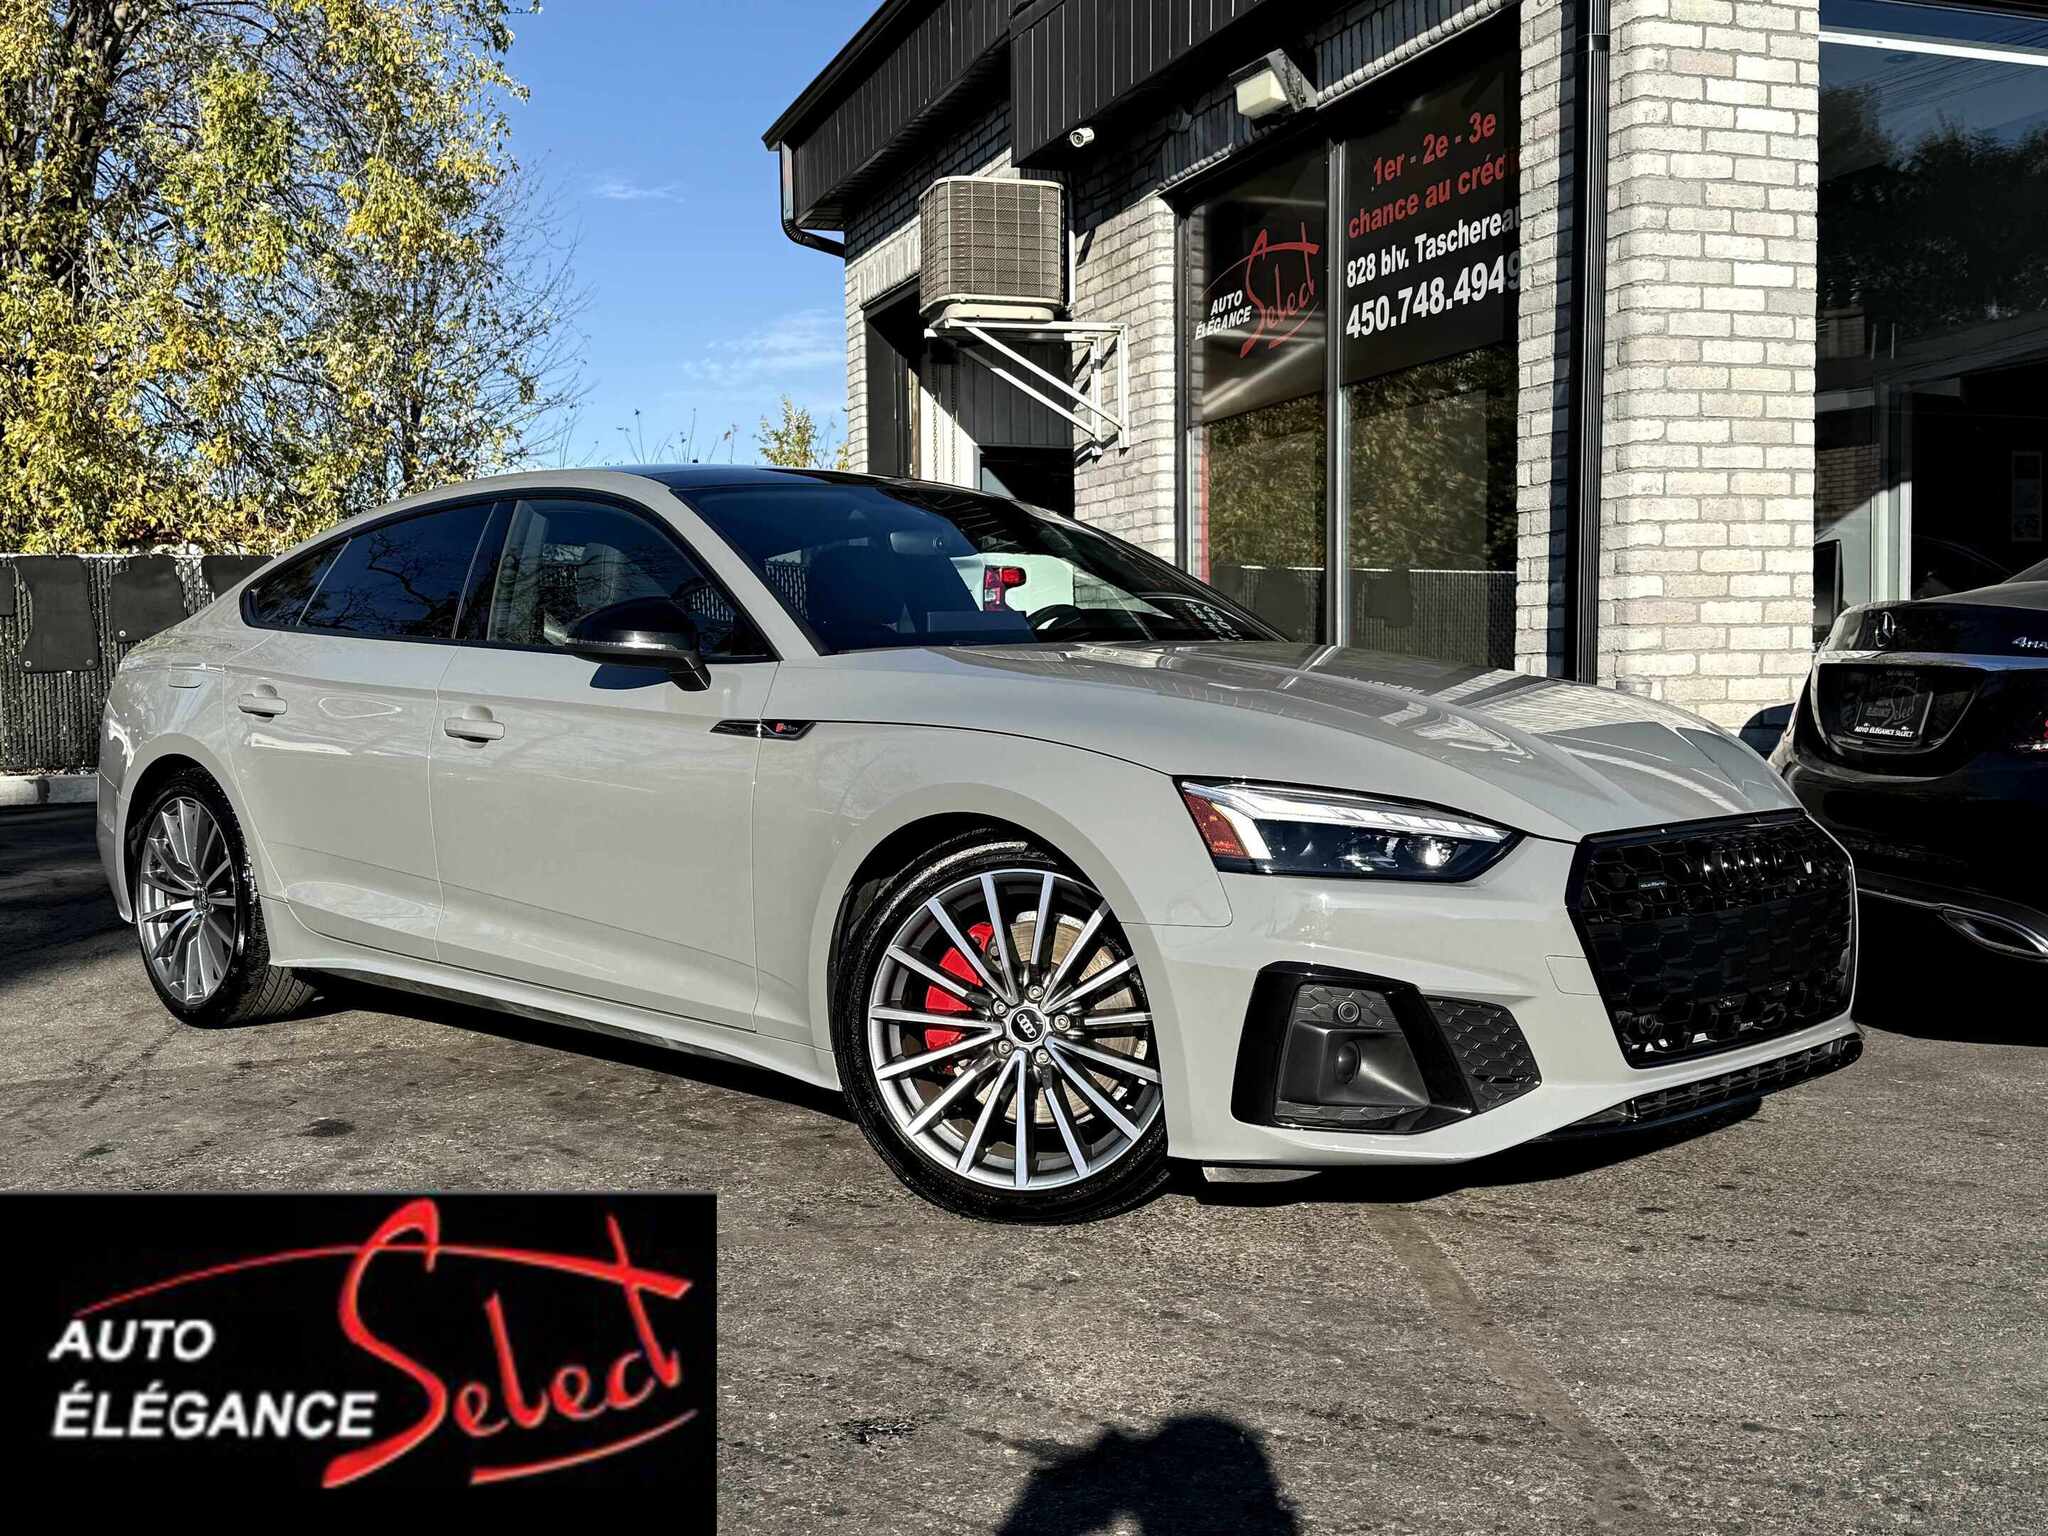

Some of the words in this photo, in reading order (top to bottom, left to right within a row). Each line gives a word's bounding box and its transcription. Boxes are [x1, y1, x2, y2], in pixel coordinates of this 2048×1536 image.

[1373, 153, 1404, 186] 1er
[1423, 132, 1449, 166] 2e
[1468, 111, 1497, 145] 3e
[1348, 198, 1419, 239] chance
[1424, 178, 1451, 209] au
[1239, 222, 1320, 359] Select
[1345, 249, 1521, 339] 450.748.4949
[1346, 252, 1376, 288] 828
[1381, 247, 1410, 277] blv.
[1194, 305, 1252, 341] ÉLÉGANCE
[1210, 289, 1243, 316] AUTO
